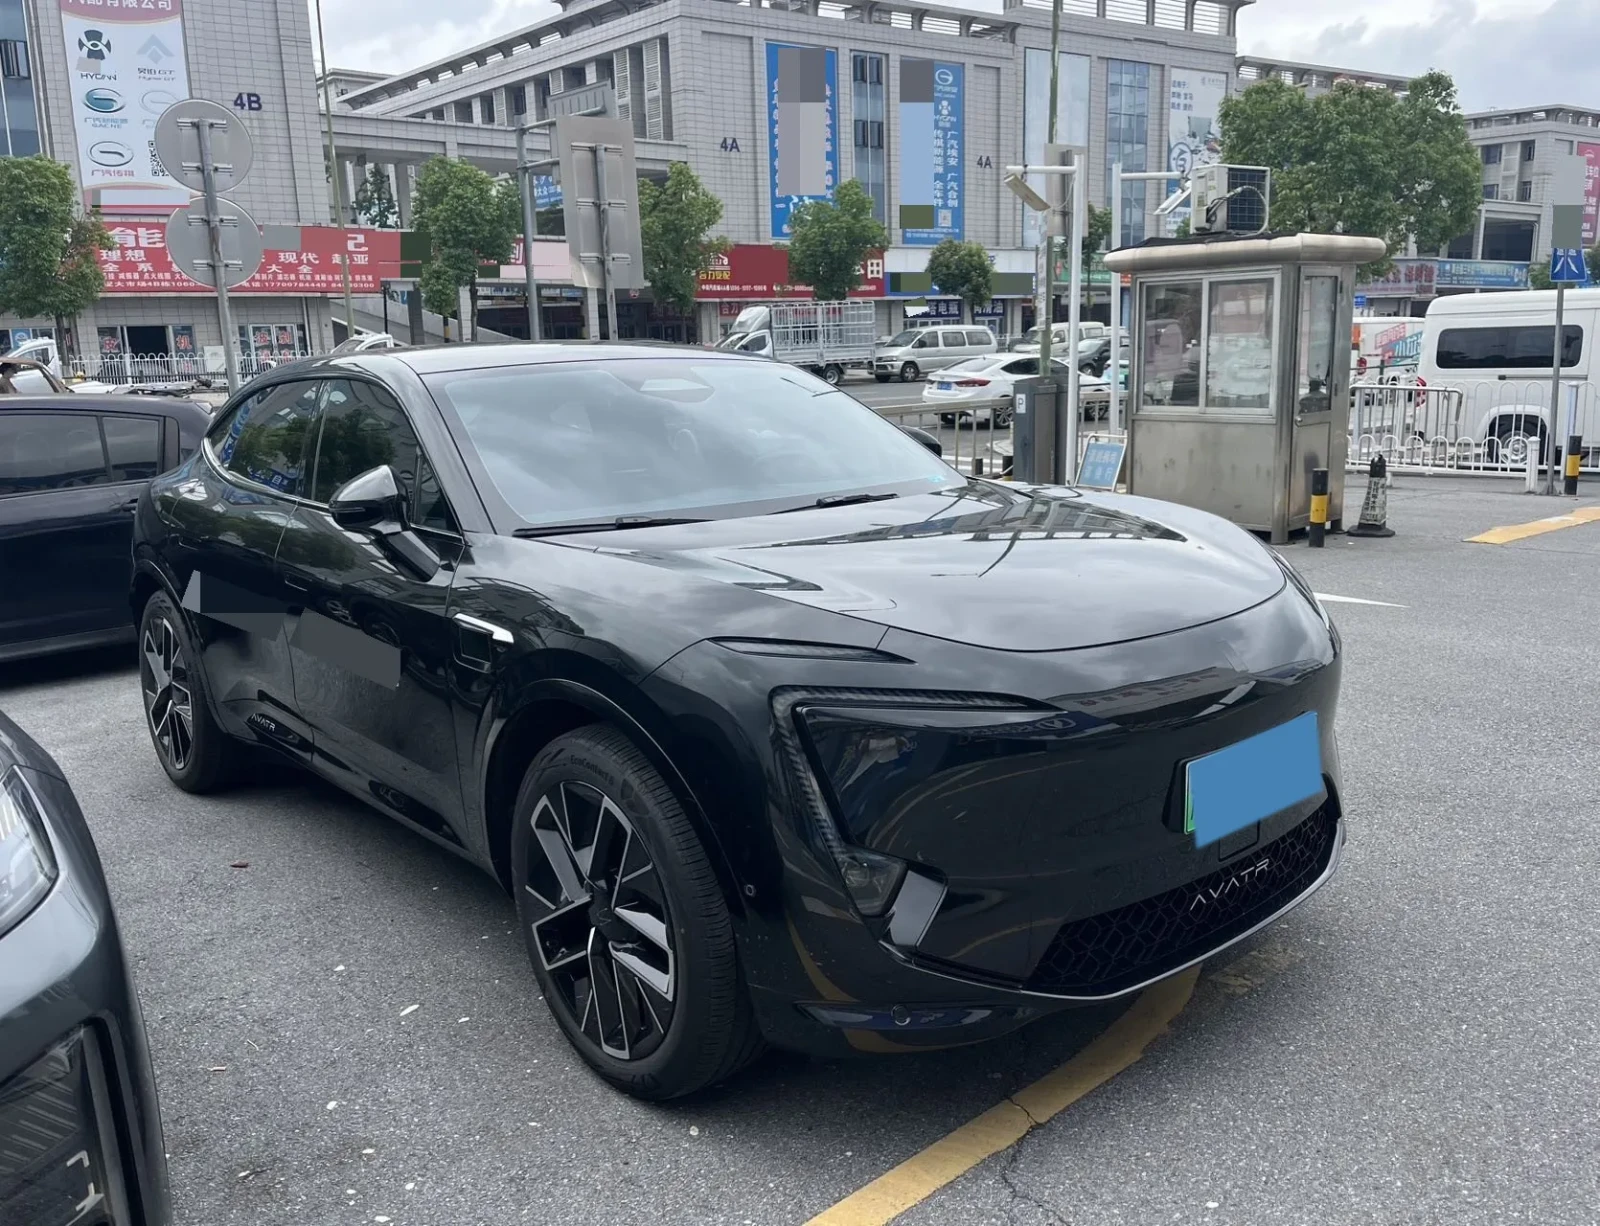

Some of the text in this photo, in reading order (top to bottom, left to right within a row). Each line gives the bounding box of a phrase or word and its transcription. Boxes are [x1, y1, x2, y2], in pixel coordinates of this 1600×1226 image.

[234, 93, 262, 110] 4B
[721, 136, 740, 152] 4A
[977, 155, 992, 169] 4A
[100, 250, 146, 261] 理想
[278, 252, 319, 264] 现代
[1018, 398, 1024, 409] P
[251, 713, 275, 731] AVATR
[1190, 859, 1269, 910] AVATR
